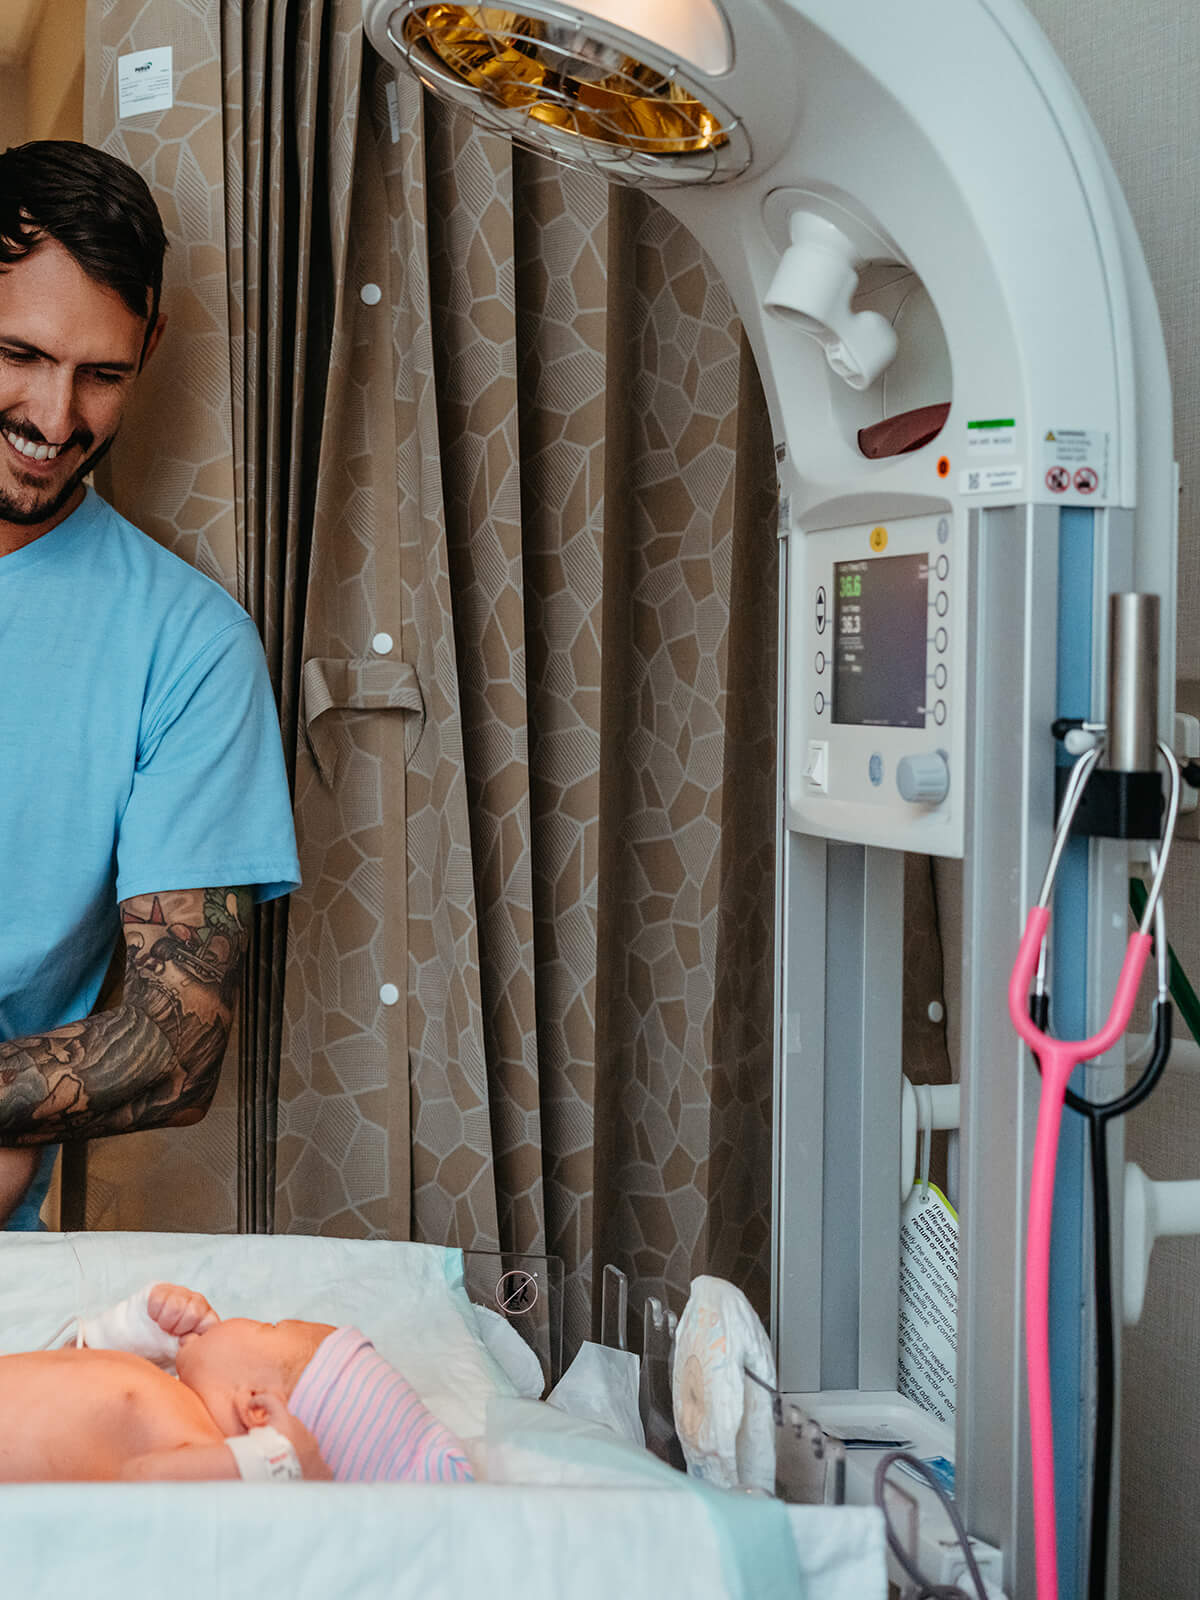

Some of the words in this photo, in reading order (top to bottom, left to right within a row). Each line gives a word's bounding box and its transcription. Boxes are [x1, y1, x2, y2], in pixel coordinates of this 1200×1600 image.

[911, 1217, 931, 1243] rectum
[929, 1242, 938, 1250] or
[918, 1213, 951, 1256] temperature
[925, 1208, 951, 1243] difference
[932, 1203, 940, 1211] If
[936, 1210, 947, 1222] the
[912, 1255, 928, 1274] using
[930, 1278, 954, 1308] reflective
[915, 1244, 925, 1257] the
[923, 1256, 944, 1281] warmer
[904, 1266, 925, 1293] warmer
[923, 1292, 955, 1333] temperature
[904, 1280, 915, 1293] the
[926, 1310, 940, 1325] and
[903, 1330, 914, 1342] the
[912, 1341, 945, 1383] independent
[905, 1346, 925, 1372] axillary,
[923, 1371, 941, 1391] rectal
[938, 1390, 946, 1398] or
[908, 1323, 924, 1343] Temp
[921, 1342, 930, 1352] as
[928, 1350, 950, 1376] needed
[947, 1375, 955, 1384] to
[899, 1376, 910, 1389] the
[909, 1376, 923, 1391] and
[919, 1390, 937, 1411] adjust
[935, 1410, 946, 1423] the
